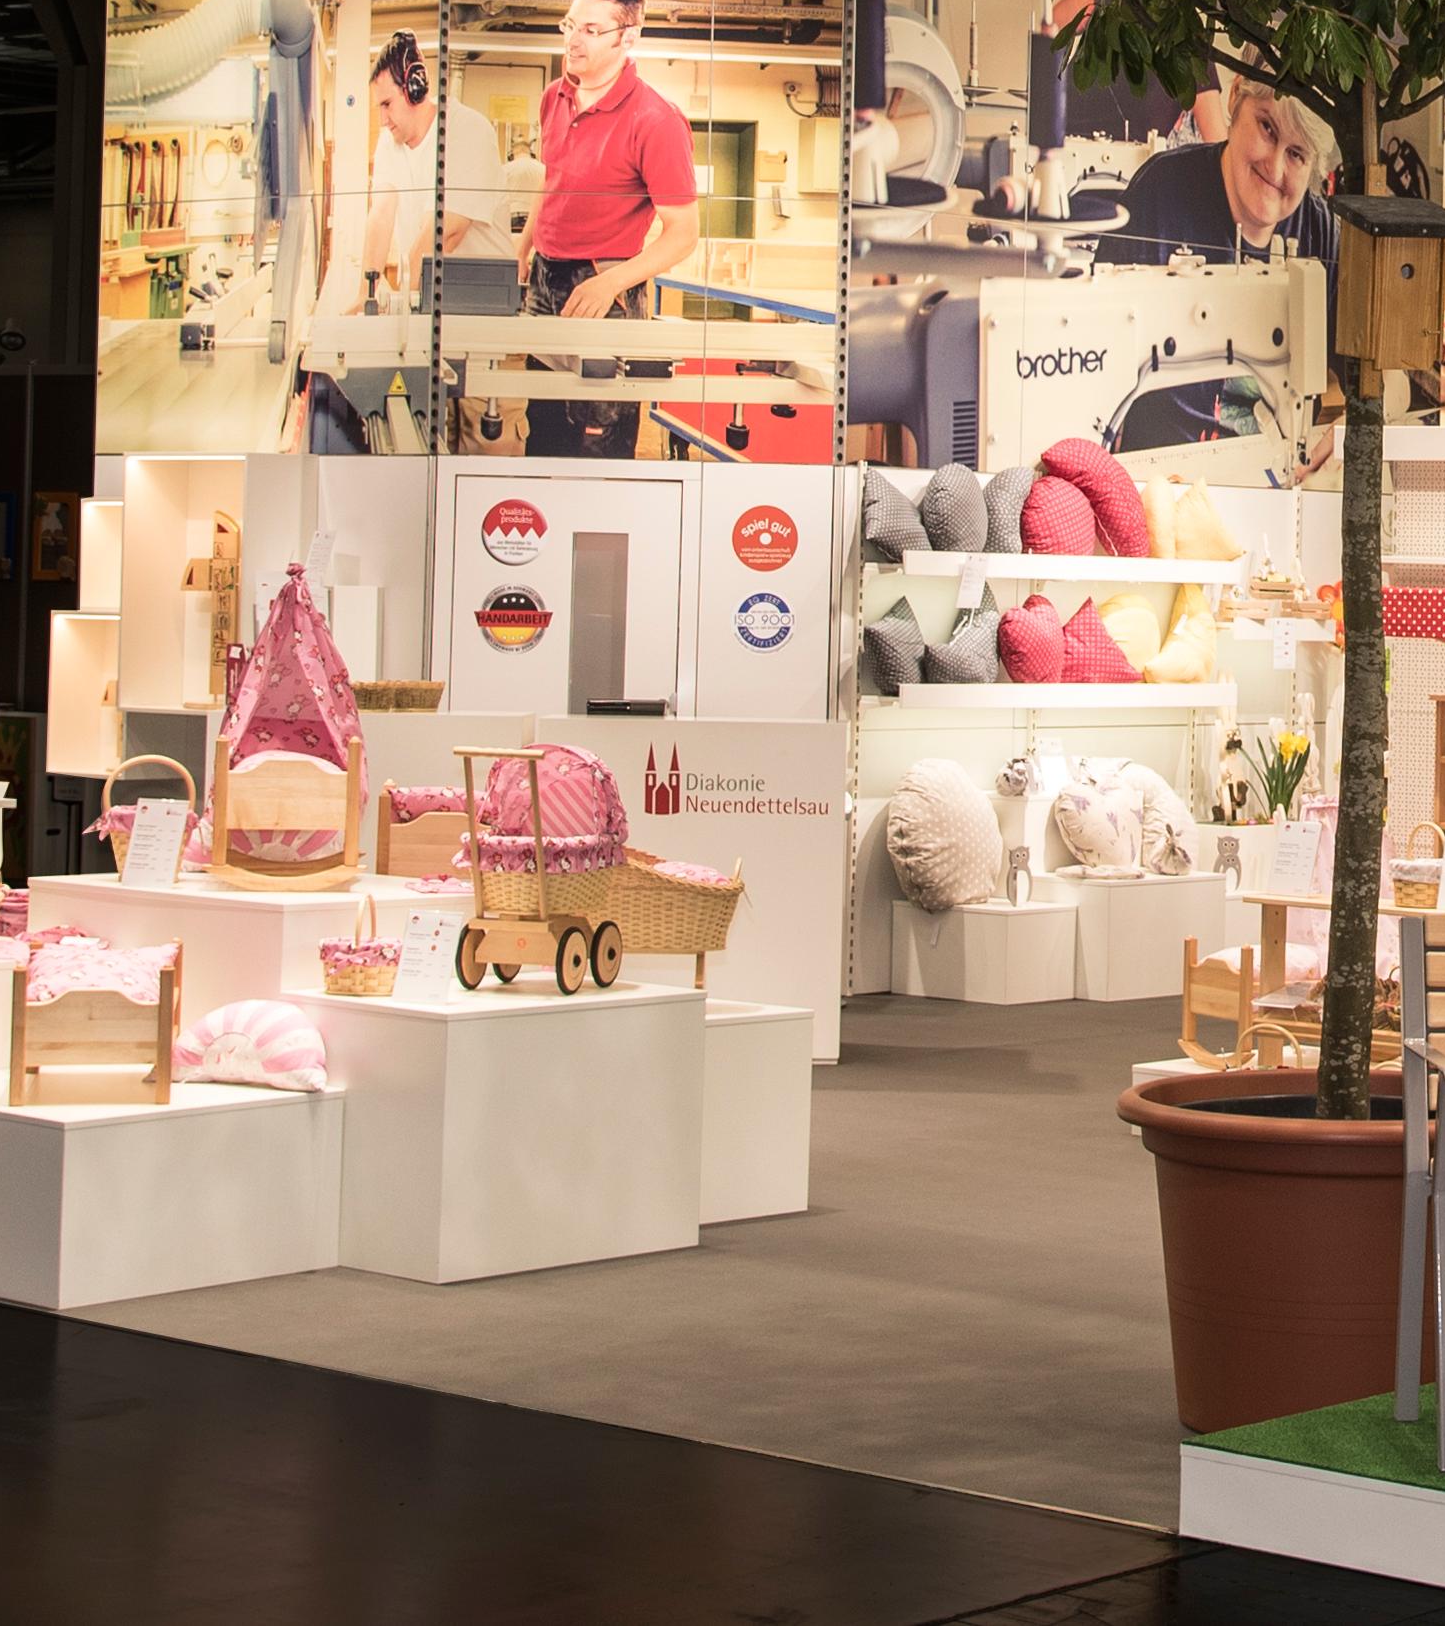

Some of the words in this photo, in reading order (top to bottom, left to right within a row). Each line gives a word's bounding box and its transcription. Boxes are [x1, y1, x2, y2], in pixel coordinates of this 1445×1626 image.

[1015, 347, 1108, 380] brother
[741, 518, 769, 538] spiel
[770, 521, 792, 538] gut
[477, 613, 548, 625] HANDARBEIT
[734, 613, 755, 626] ISO
[685, 773, 766, 792] Diakonie
[685, 794, 829, 816] Neuendettelsau
